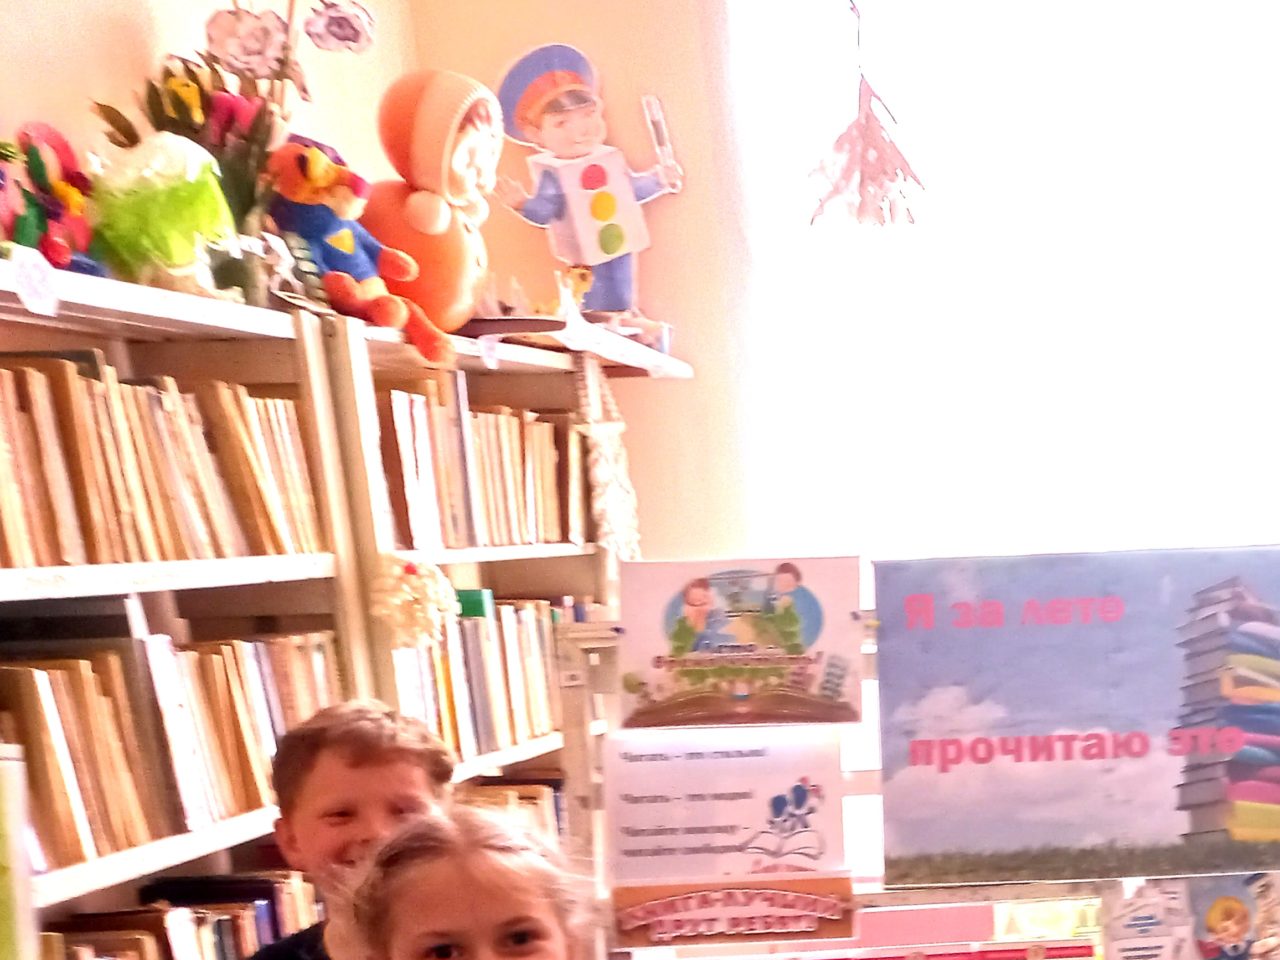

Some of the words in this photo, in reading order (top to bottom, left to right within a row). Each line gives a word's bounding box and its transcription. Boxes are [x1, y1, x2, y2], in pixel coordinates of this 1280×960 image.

[904, 593, 934, 630] Я
[950, 599, 1006, 629] за
[1020, 595, 1127, 626] лето
[908, 730, 1151, 773] прочитаю
[1167, 726, 1246, 758] это
